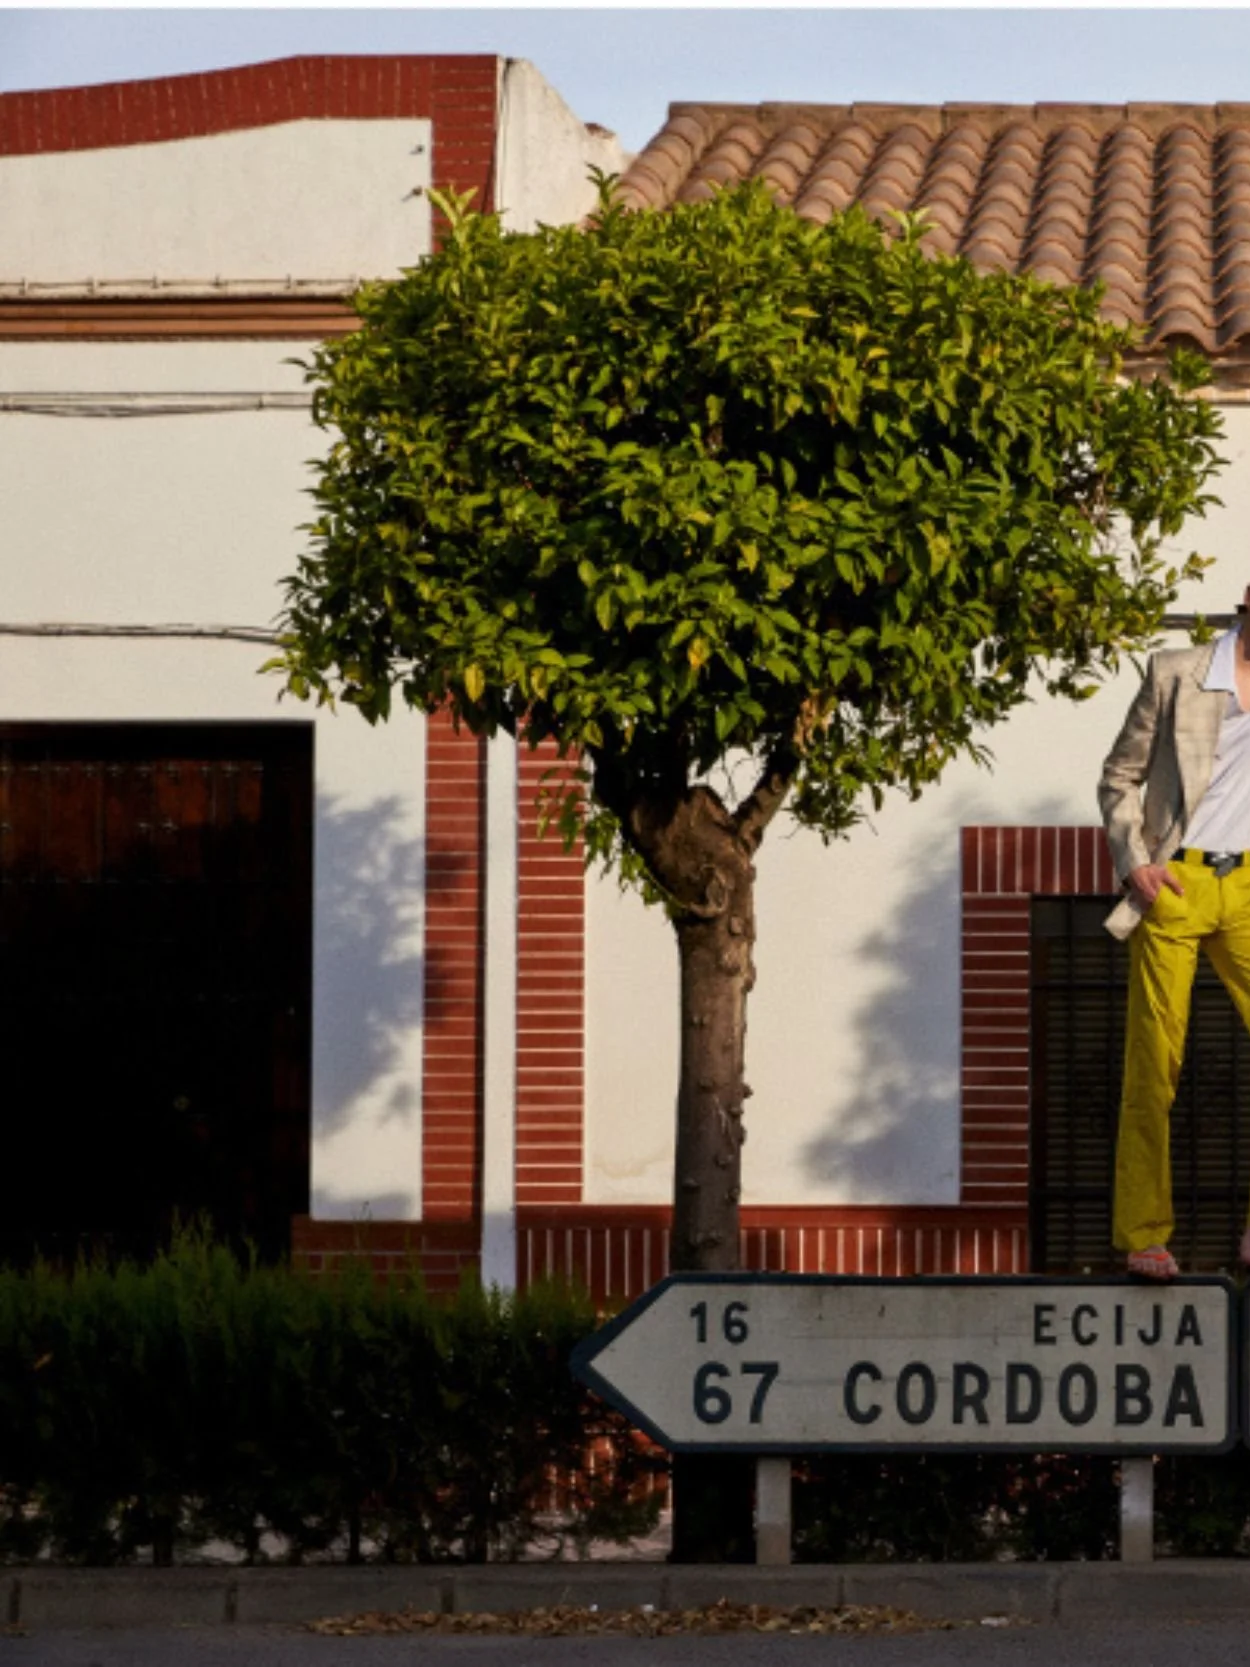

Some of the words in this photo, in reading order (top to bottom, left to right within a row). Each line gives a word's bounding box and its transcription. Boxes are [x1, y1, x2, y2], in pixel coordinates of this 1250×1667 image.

[690, 1302, 749, 1344] 16
[1033, 1303, 1203, 1346] ECIJA
[692, 1361, 780, 1425] 67
[842, 1360, 1205, 1428] CORDOBA
